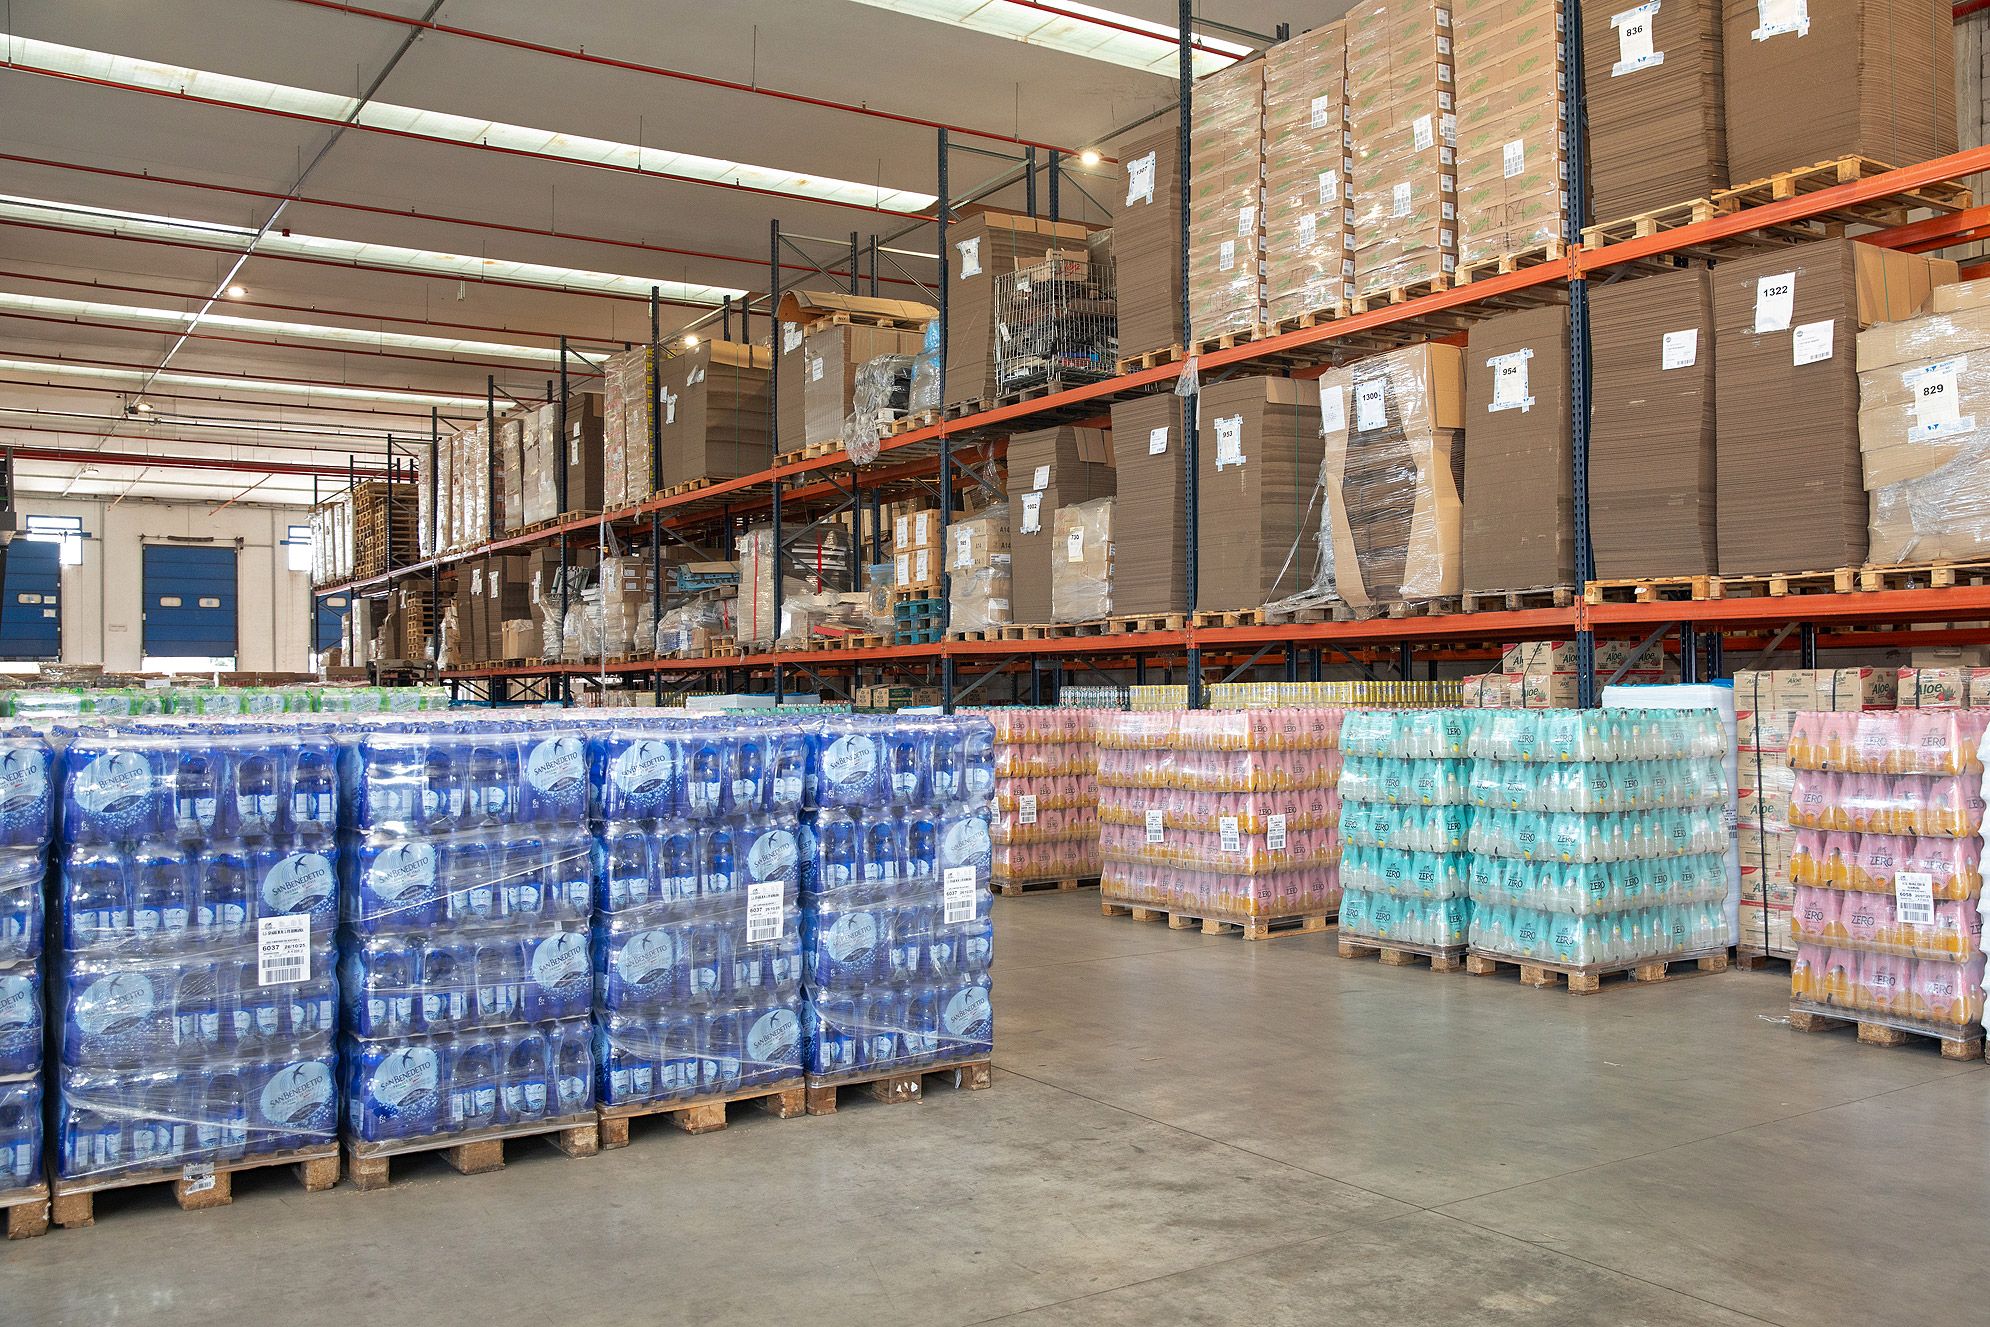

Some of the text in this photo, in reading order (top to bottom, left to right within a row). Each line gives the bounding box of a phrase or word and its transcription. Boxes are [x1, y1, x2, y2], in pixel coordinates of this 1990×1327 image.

[1626, 25, 1643, 37] 836
[1763, 285, 1788, 297] 1322
[1502, 367, 1517, 375] 954
[1924, 384, 1944, 396] 829
[1363, 392, 1378, 401] 1300
[1606, 652, 1622, 662] Aloe
[1872, 682, 1889, 696] Aloe
[1447, 727, 1461, 735] ZERO
[1518, 735, 1534, 743] ZERO
[1555, 735, 1573, 743] ZERO
[1921, 737, 1946, 746] ZERO
[1385, 779, 1399, 787] ZERO
[1418, 780, 1434, 788] ZERO
[1591, 780, 1607, 789] ZERO
[1624, 780, 1638, 788] ZERO
[1803, 793, 1823, 804] ZERO
[1750, 804, 1774, 815] Aoe
[1375, 823, 1389, 832] ZERO
[1447, 822, 1461, 830] ZERO
[1520, 833, 1535, 842] ZERO
[1674, 830, 1686, 838] ZERO
[1870, 856, 1894, 867] ZERO
[1923, 860, 1949, 872] ZERO
[1386, 870, 1400, 879] ZERO
[1418, 873, 1434, 881] ZERO
[1682, 873, 1695, 881] ZERO
[1625, 877, 1639, 887] ZERO
[1654, 875, 1667, 884] ZERO
[1590, 882, 1605, 890] ZERO
[1752, 882, 1778, 893] Aoe
[1346, 908, 1358, 917] ZERO
[1375, 912, 1390, 921] ZERO
[1803, 909, 1823, 921] ZERO
[1851, 914, 1875, 926] ZERO
[1520, 930, 1535, 940] ZERO
[1556, 935, 1574, 945] ZERO
[1872, 975, 1896, 987] ZERO
[1926, 985, 1953, 995] ZERO
